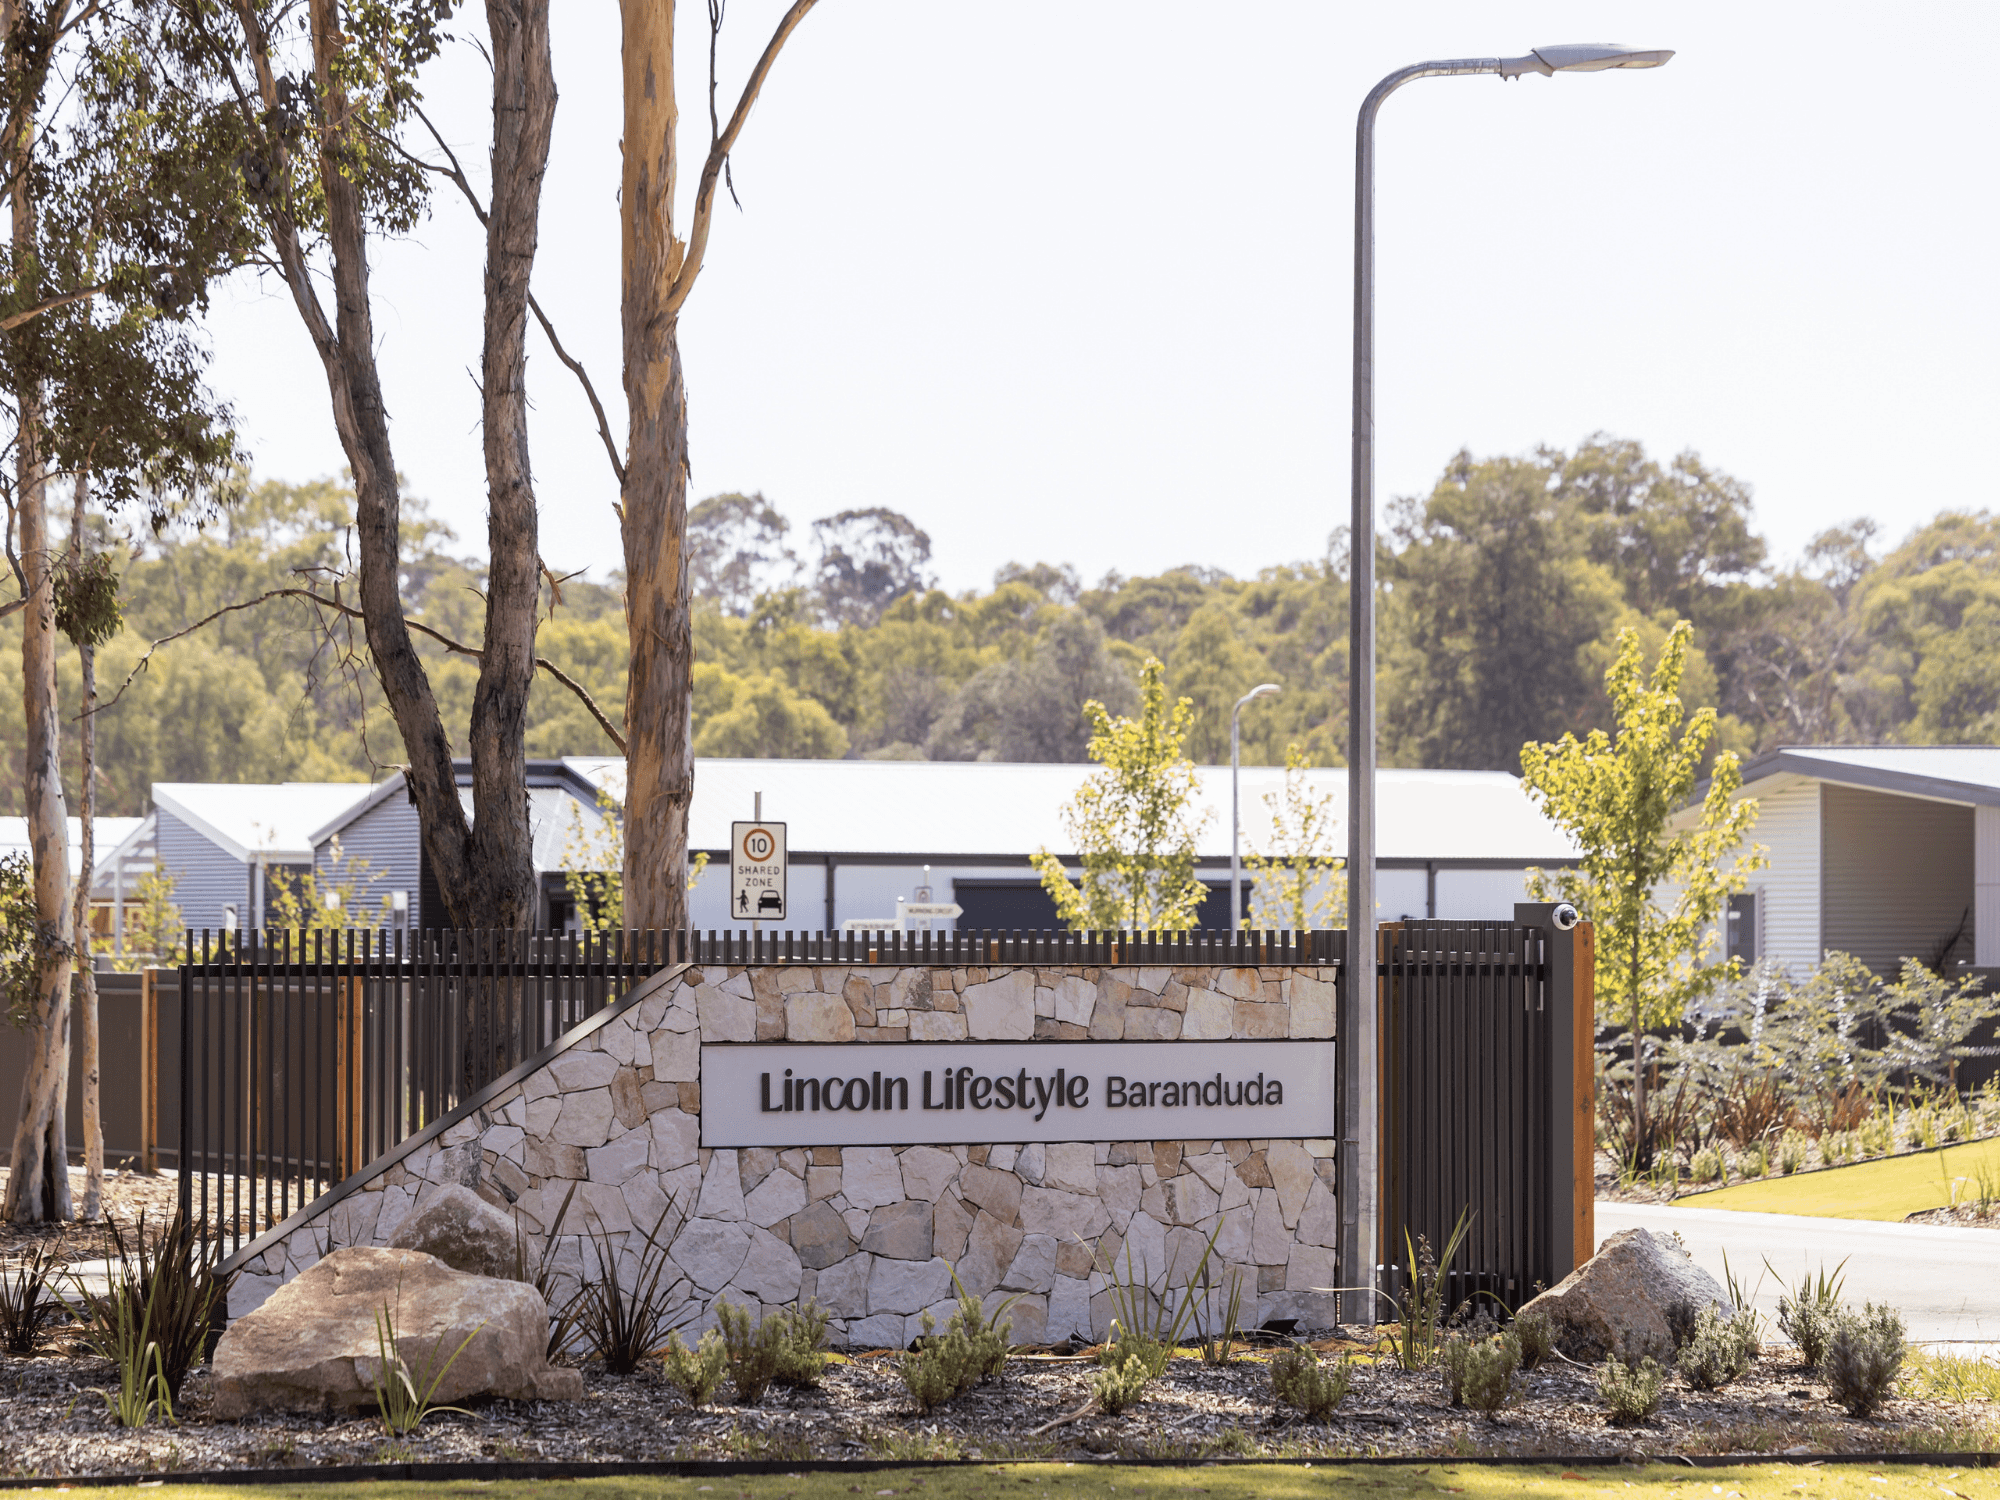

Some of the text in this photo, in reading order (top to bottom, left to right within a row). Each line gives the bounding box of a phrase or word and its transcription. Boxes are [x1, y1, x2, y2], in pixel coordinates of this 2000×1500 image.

[751, 838, 767, 853] 10
[738, 865, 780, 875] SHARED
[745, 878, 773, 887] ZONE
[760, 1067, 1283, 1122] Lincoln Lifestyle Baranduda
